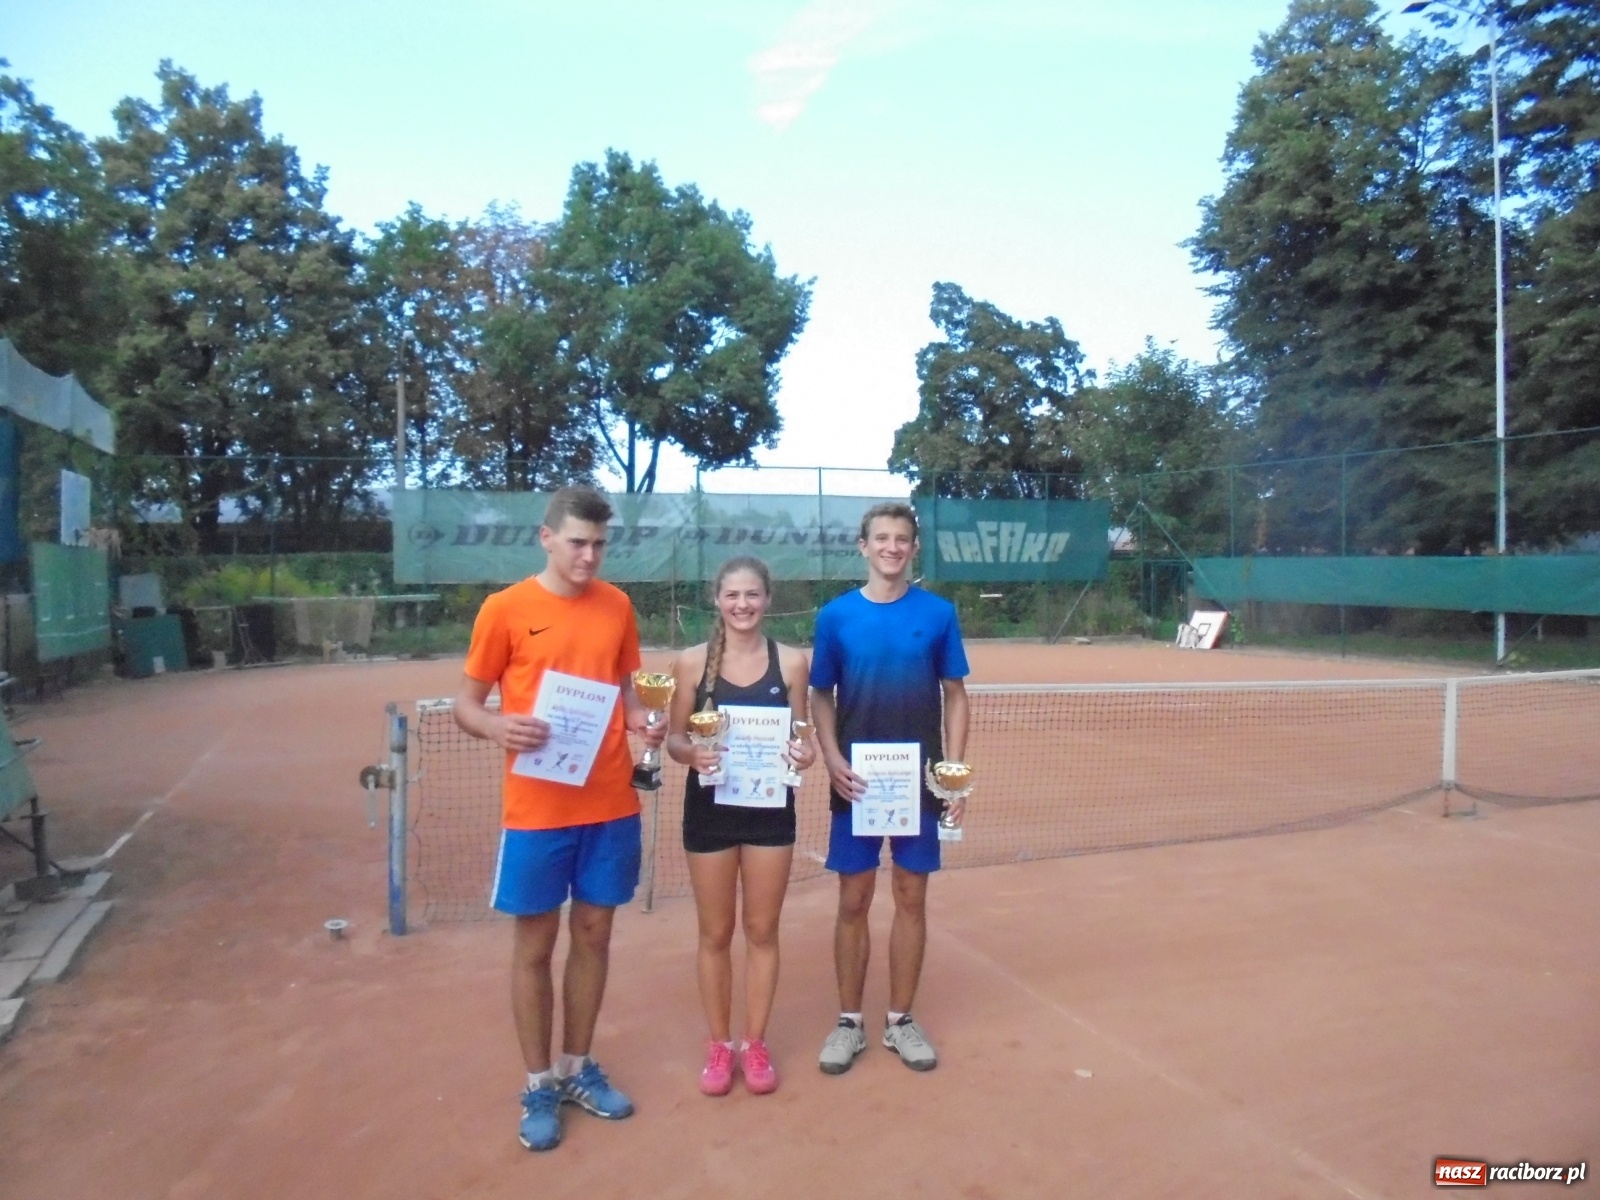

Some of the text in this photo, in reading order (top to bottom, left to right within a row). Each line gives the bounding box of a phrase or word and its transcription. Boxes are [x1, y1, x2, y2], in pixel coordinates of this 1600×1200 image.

[714, 526, 861, 546] DUNLO
[556, 684, 606, 704] DYPLOM
[732, 717, 780, 727] DYPLOM
[864, 753, 910, 761] DYPLOM
